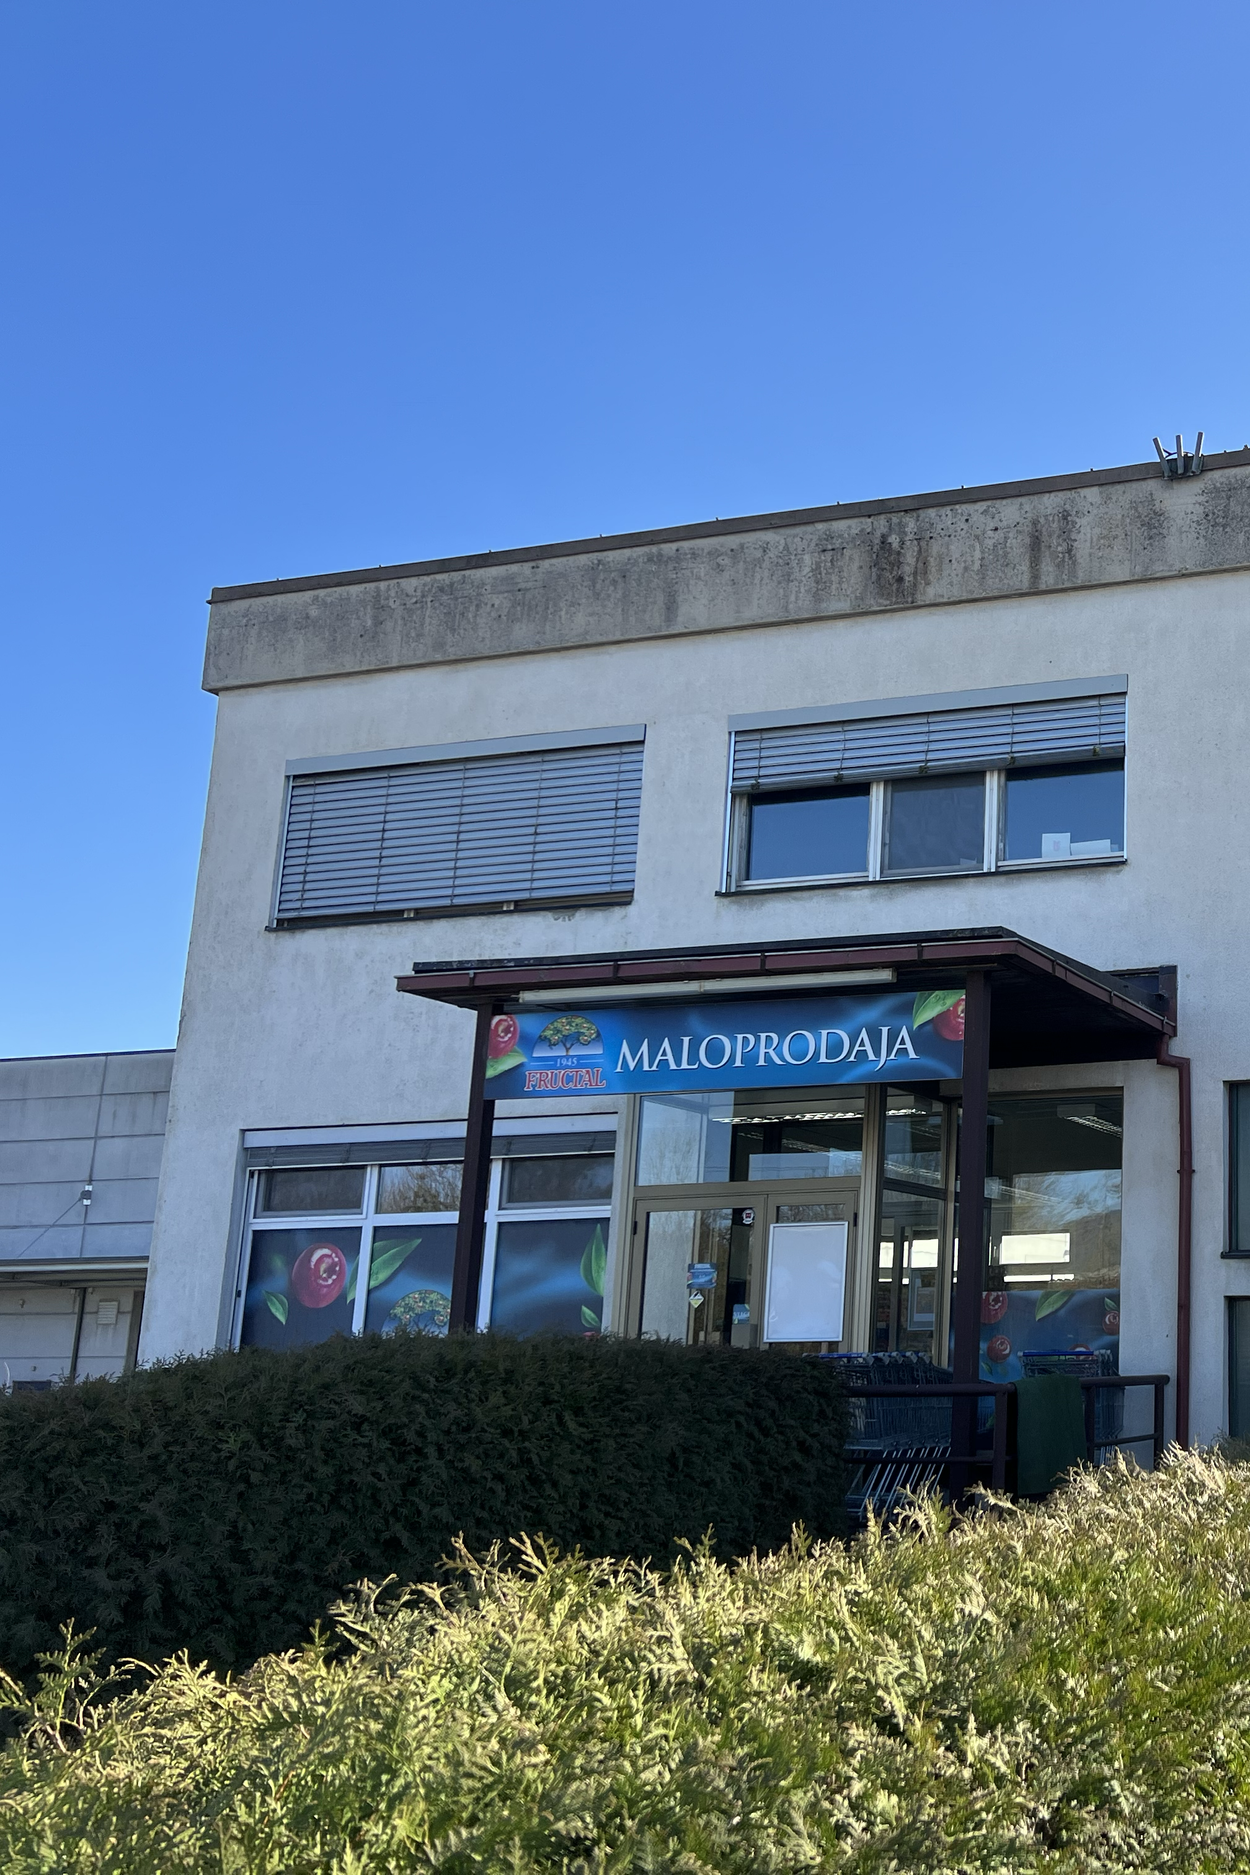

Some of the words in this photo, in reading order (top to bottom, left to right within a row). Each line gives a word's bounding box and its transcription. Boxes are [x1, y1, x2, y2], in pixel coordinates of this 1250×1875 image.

[614, 1025, 919, 1073] MALOPRODAJA
[556, 1057, 577, 1067] 1945
[524, 1068, 606, 1091] FRUCTAL
